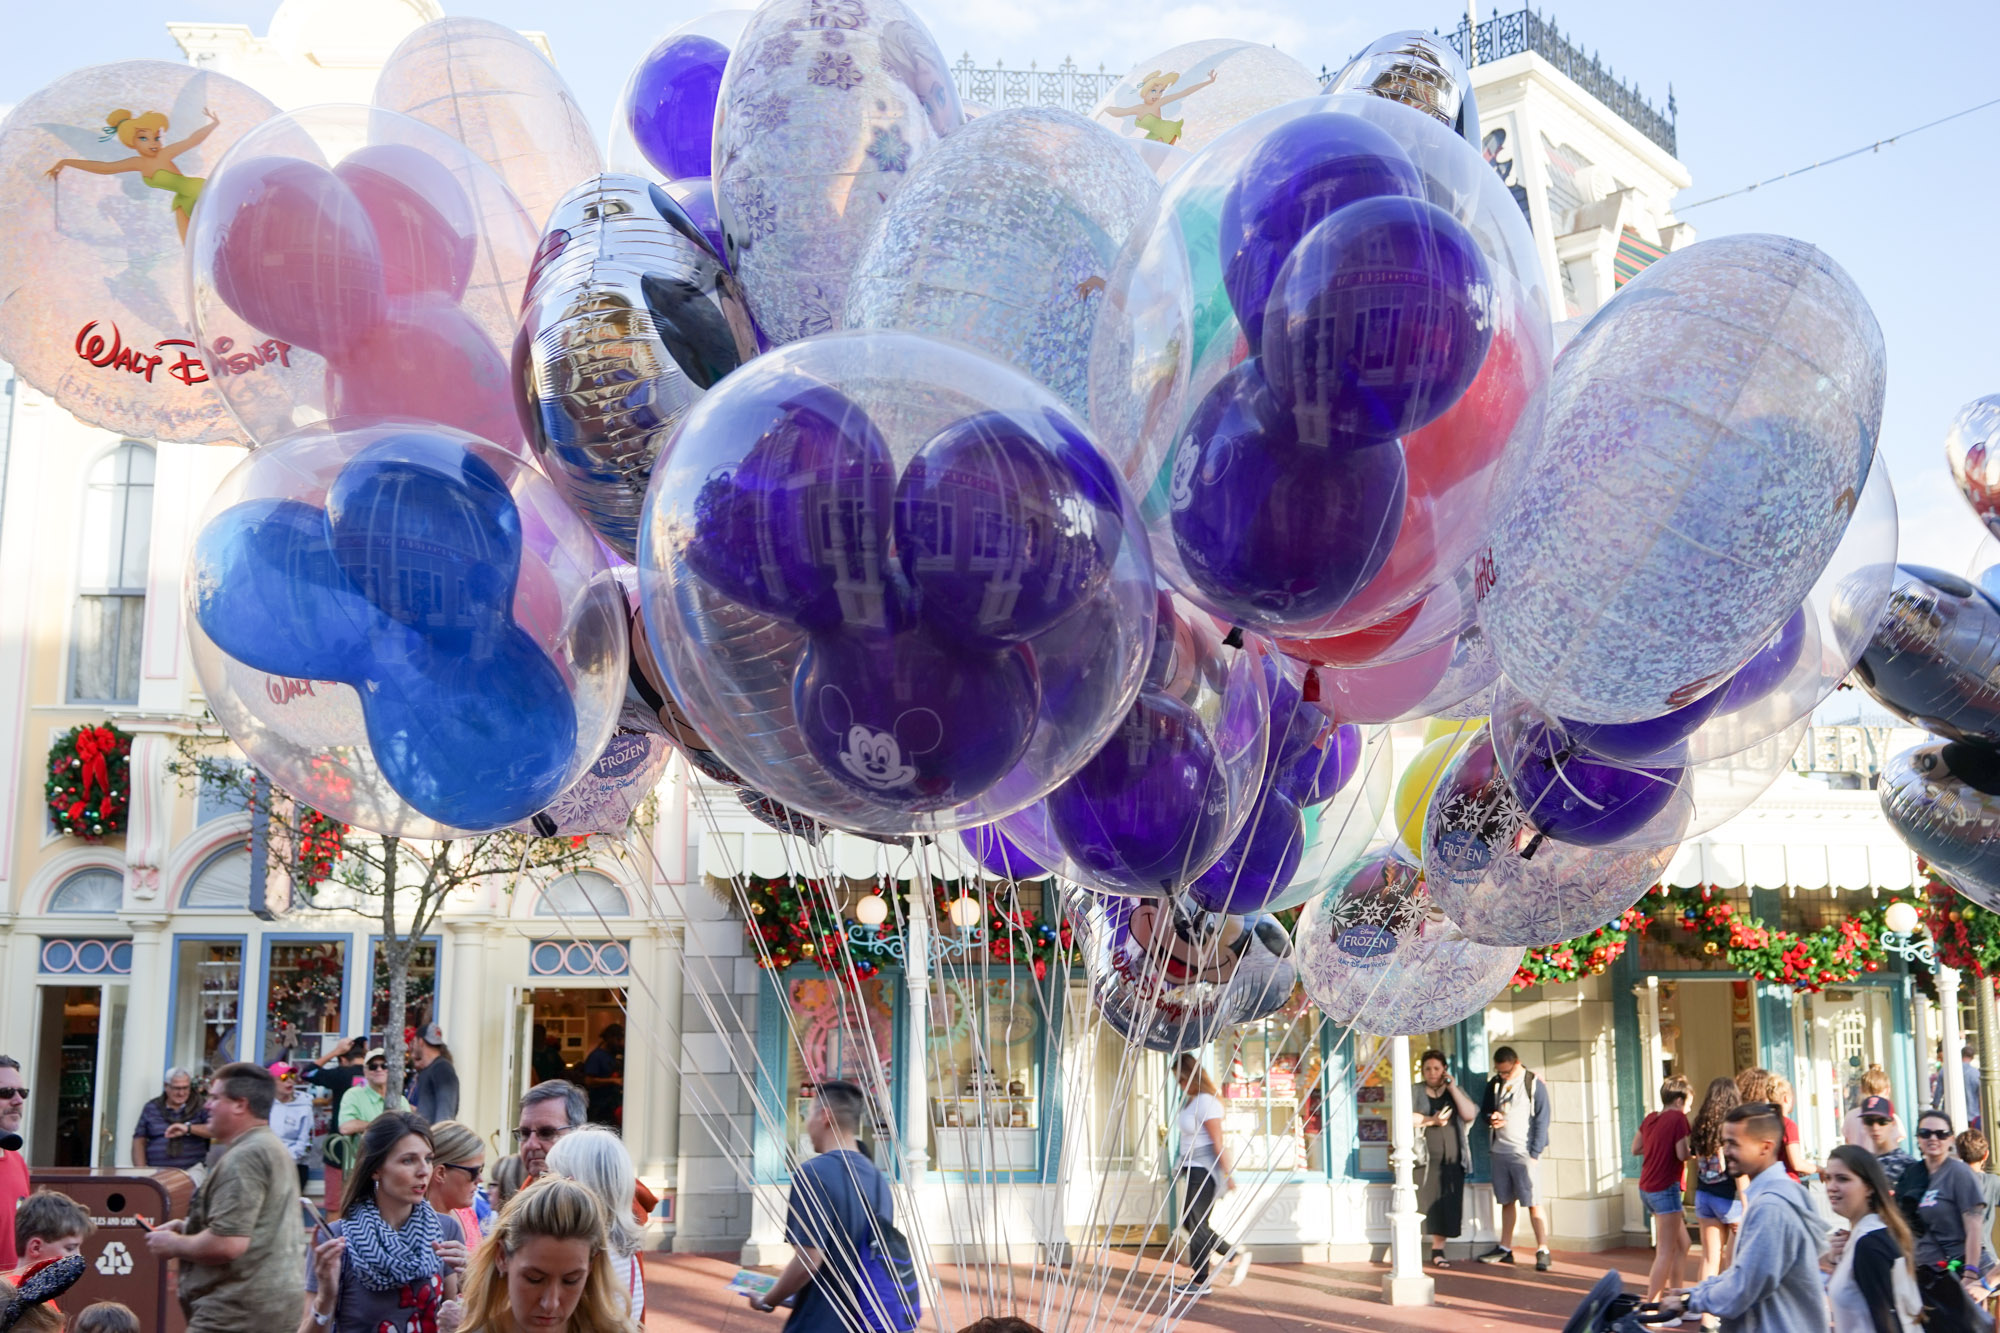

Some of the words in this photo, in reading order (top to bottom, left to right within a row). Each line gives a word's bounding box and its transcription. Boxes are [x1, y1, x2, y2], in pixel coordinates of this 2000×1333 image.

[599, 741, 645, 773] FROZEN
[1343, 935, 1389, 949] FROZEN
[107, 1216, 120, 1226] AND
[120, 1216, 137, 1226] CANS
